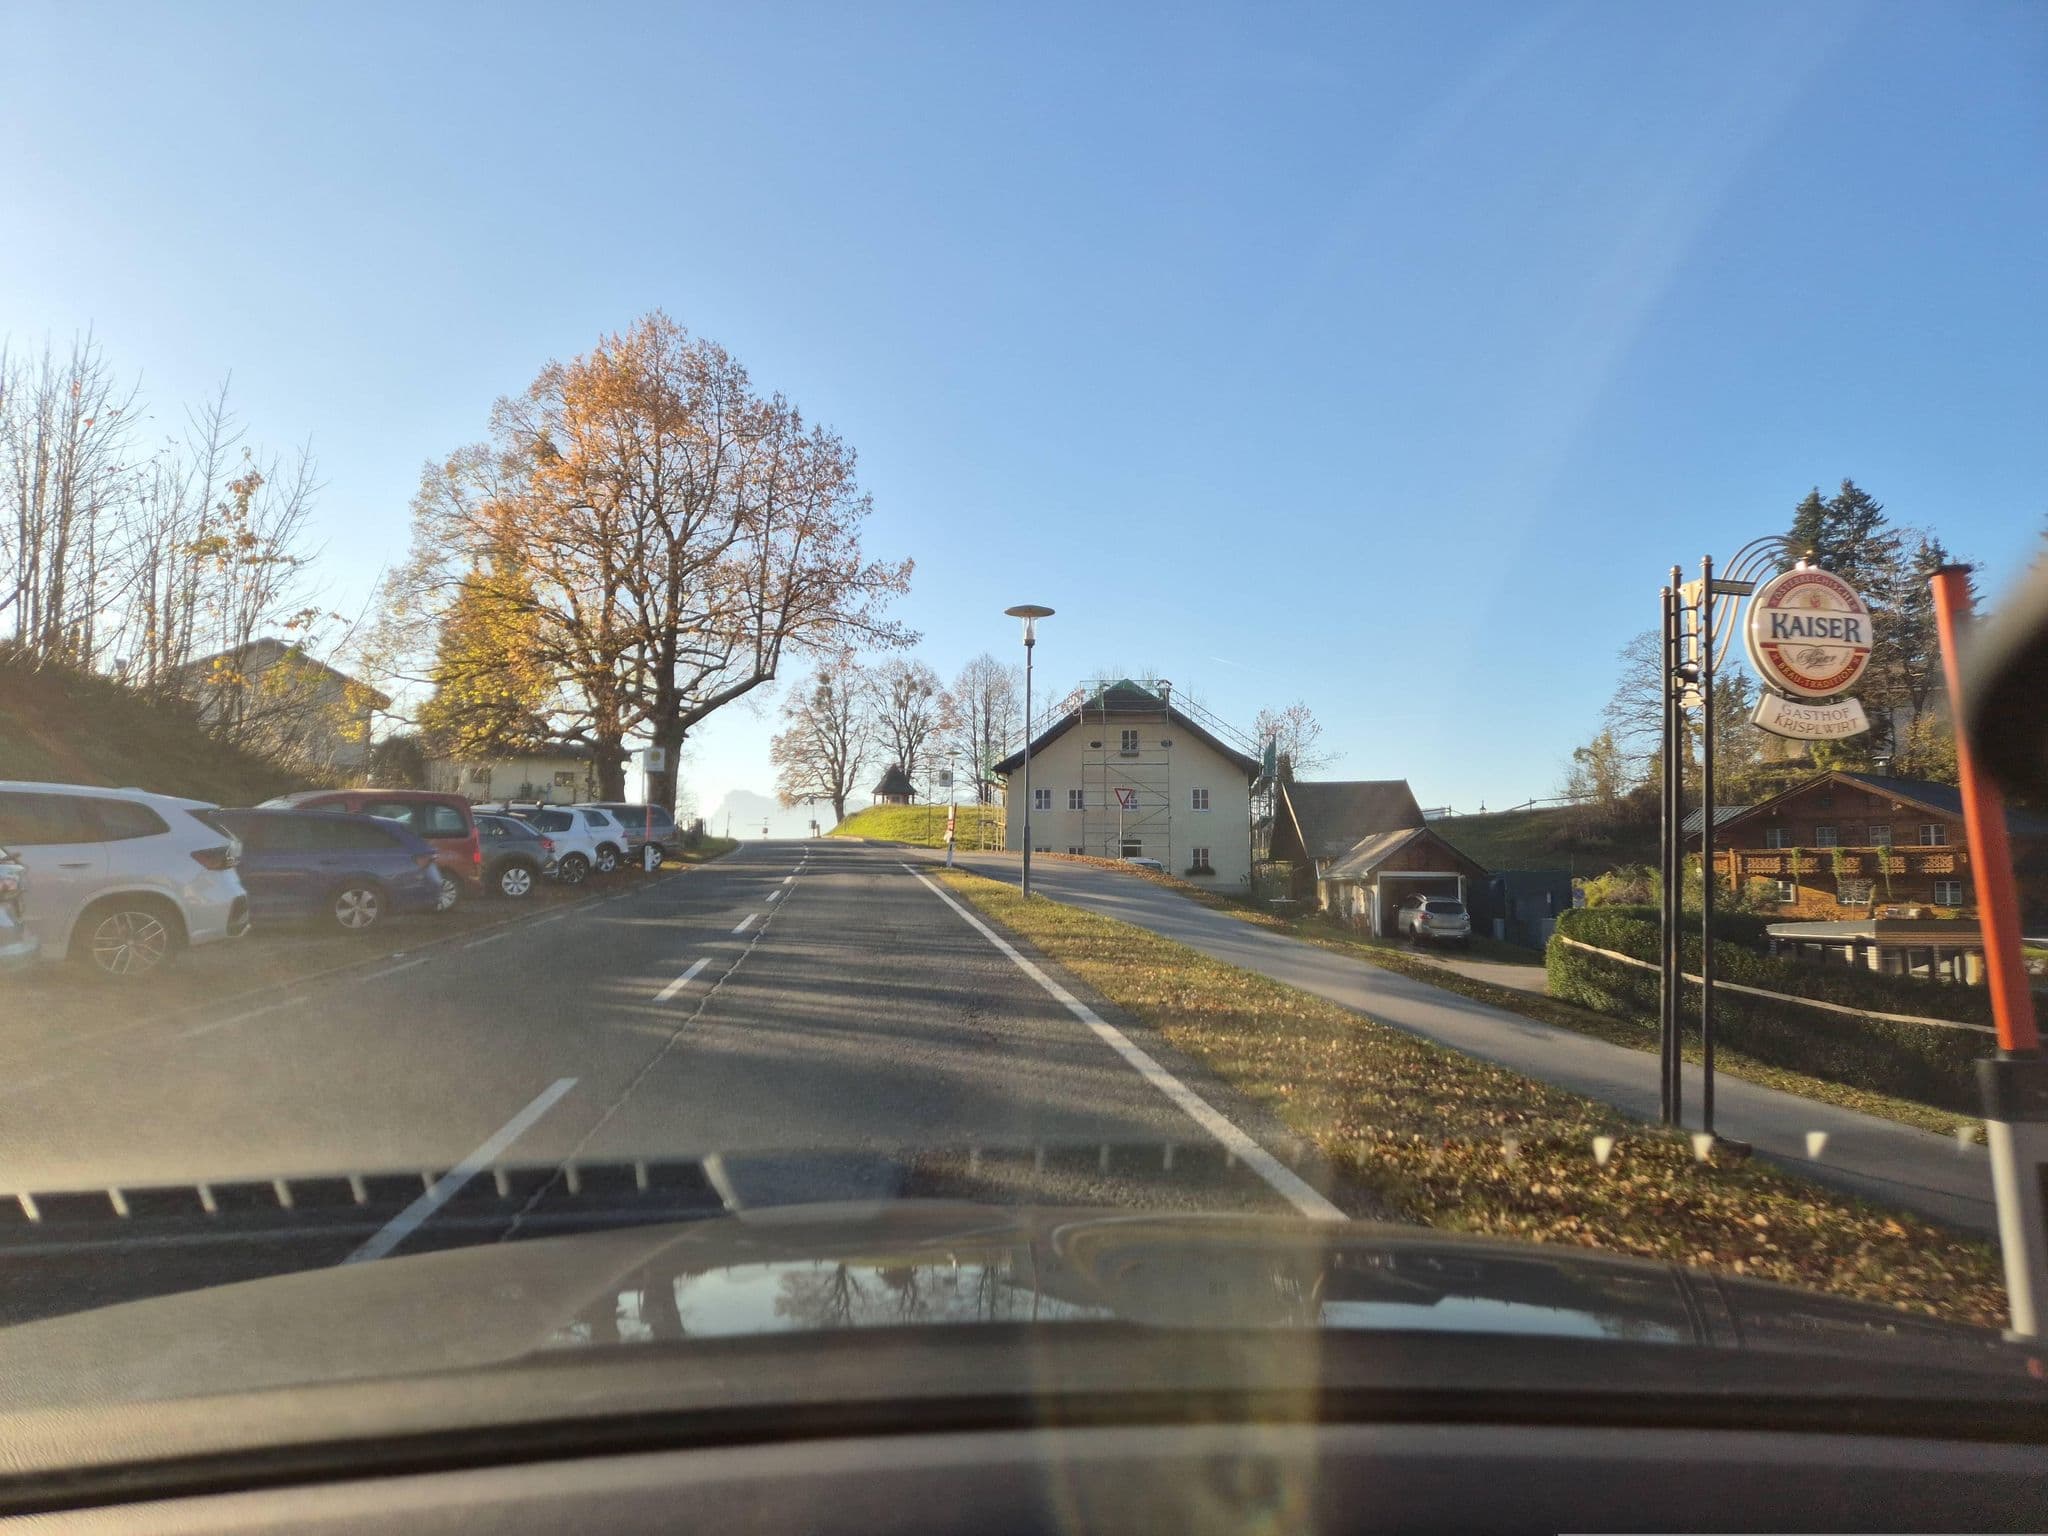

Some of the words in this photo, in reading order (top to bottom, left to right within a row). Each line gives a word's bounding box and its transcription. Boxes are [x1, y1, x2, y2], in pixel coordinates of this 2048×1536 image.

[1770, 613, 1861, 643] KAISER
[1774, 712, 1857, 734] KRISPLWIRT
[1782, 704, 1849, 720] GASTHOF
